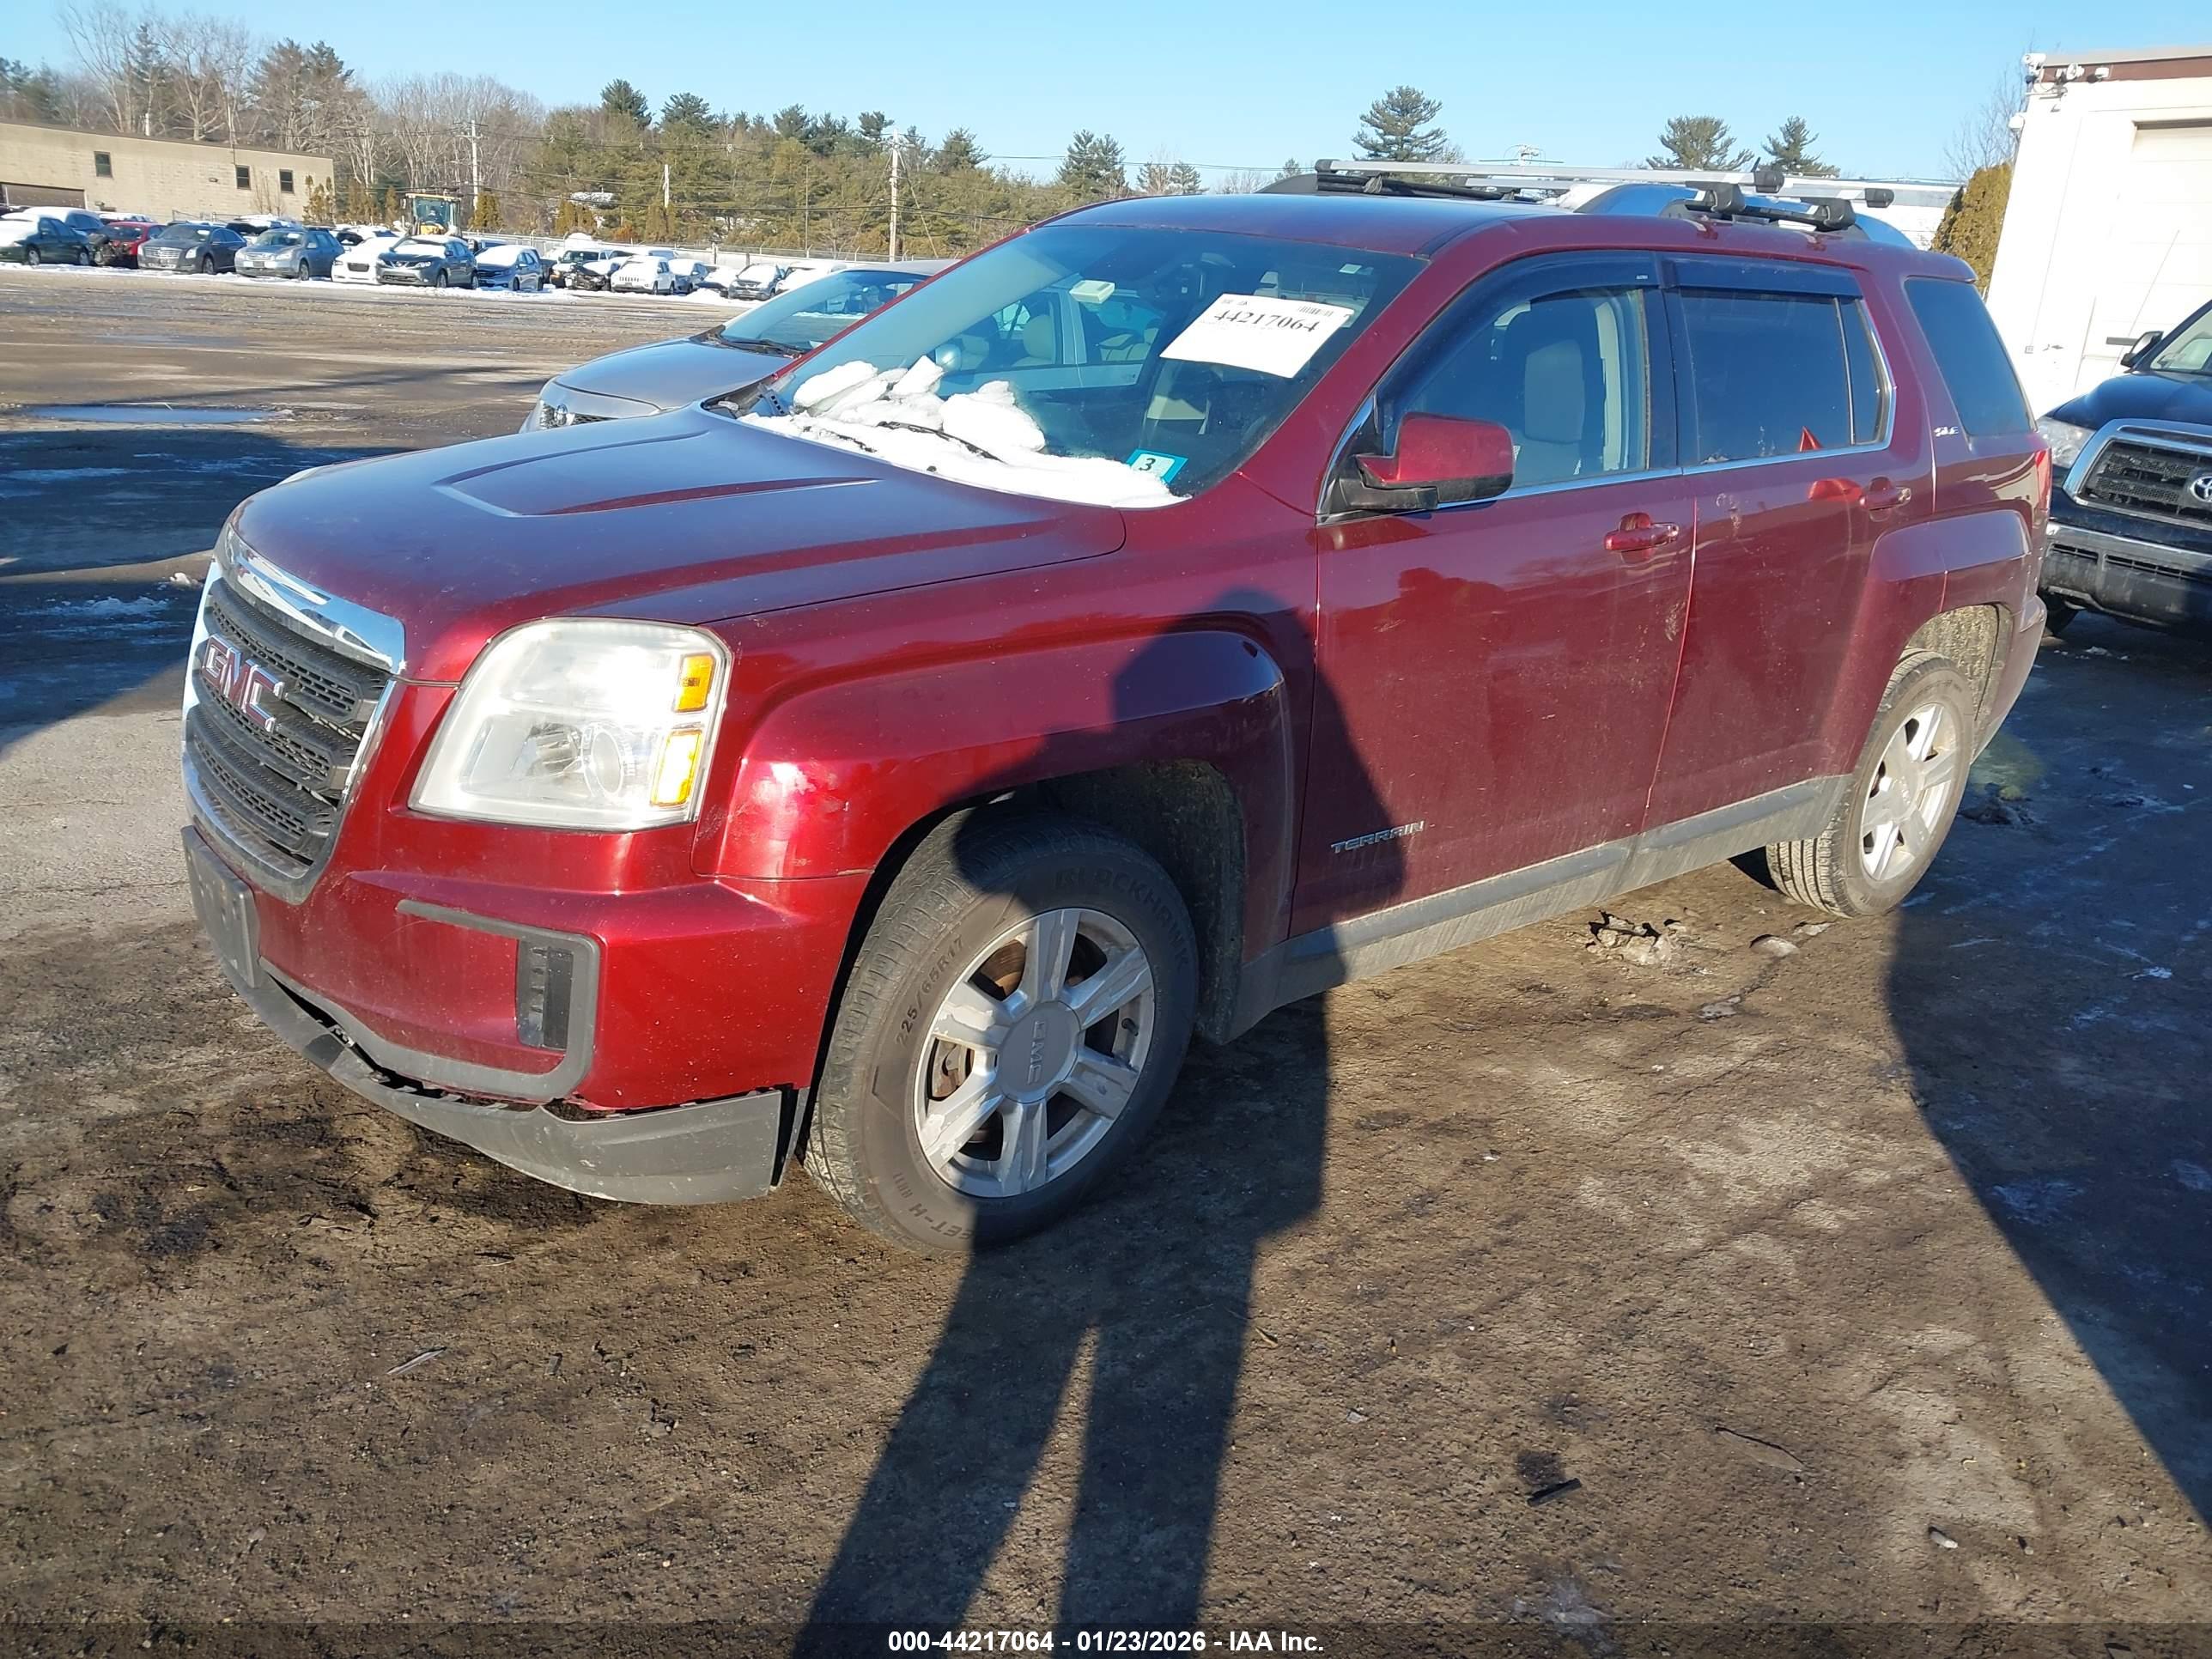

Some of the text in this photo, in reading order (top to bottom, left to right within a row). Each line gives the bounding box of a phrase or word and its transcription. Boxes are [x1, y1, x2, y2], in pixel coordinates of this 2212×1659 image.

[1213, 308, 1320, 333] 44217064
[1138, 458, 1157, 471] 3
[201, 633, 285, 733] GMC
[1330, 820, 1425, 854] TERRAIN
[1026, 1018, 1046, 1085] GMC
